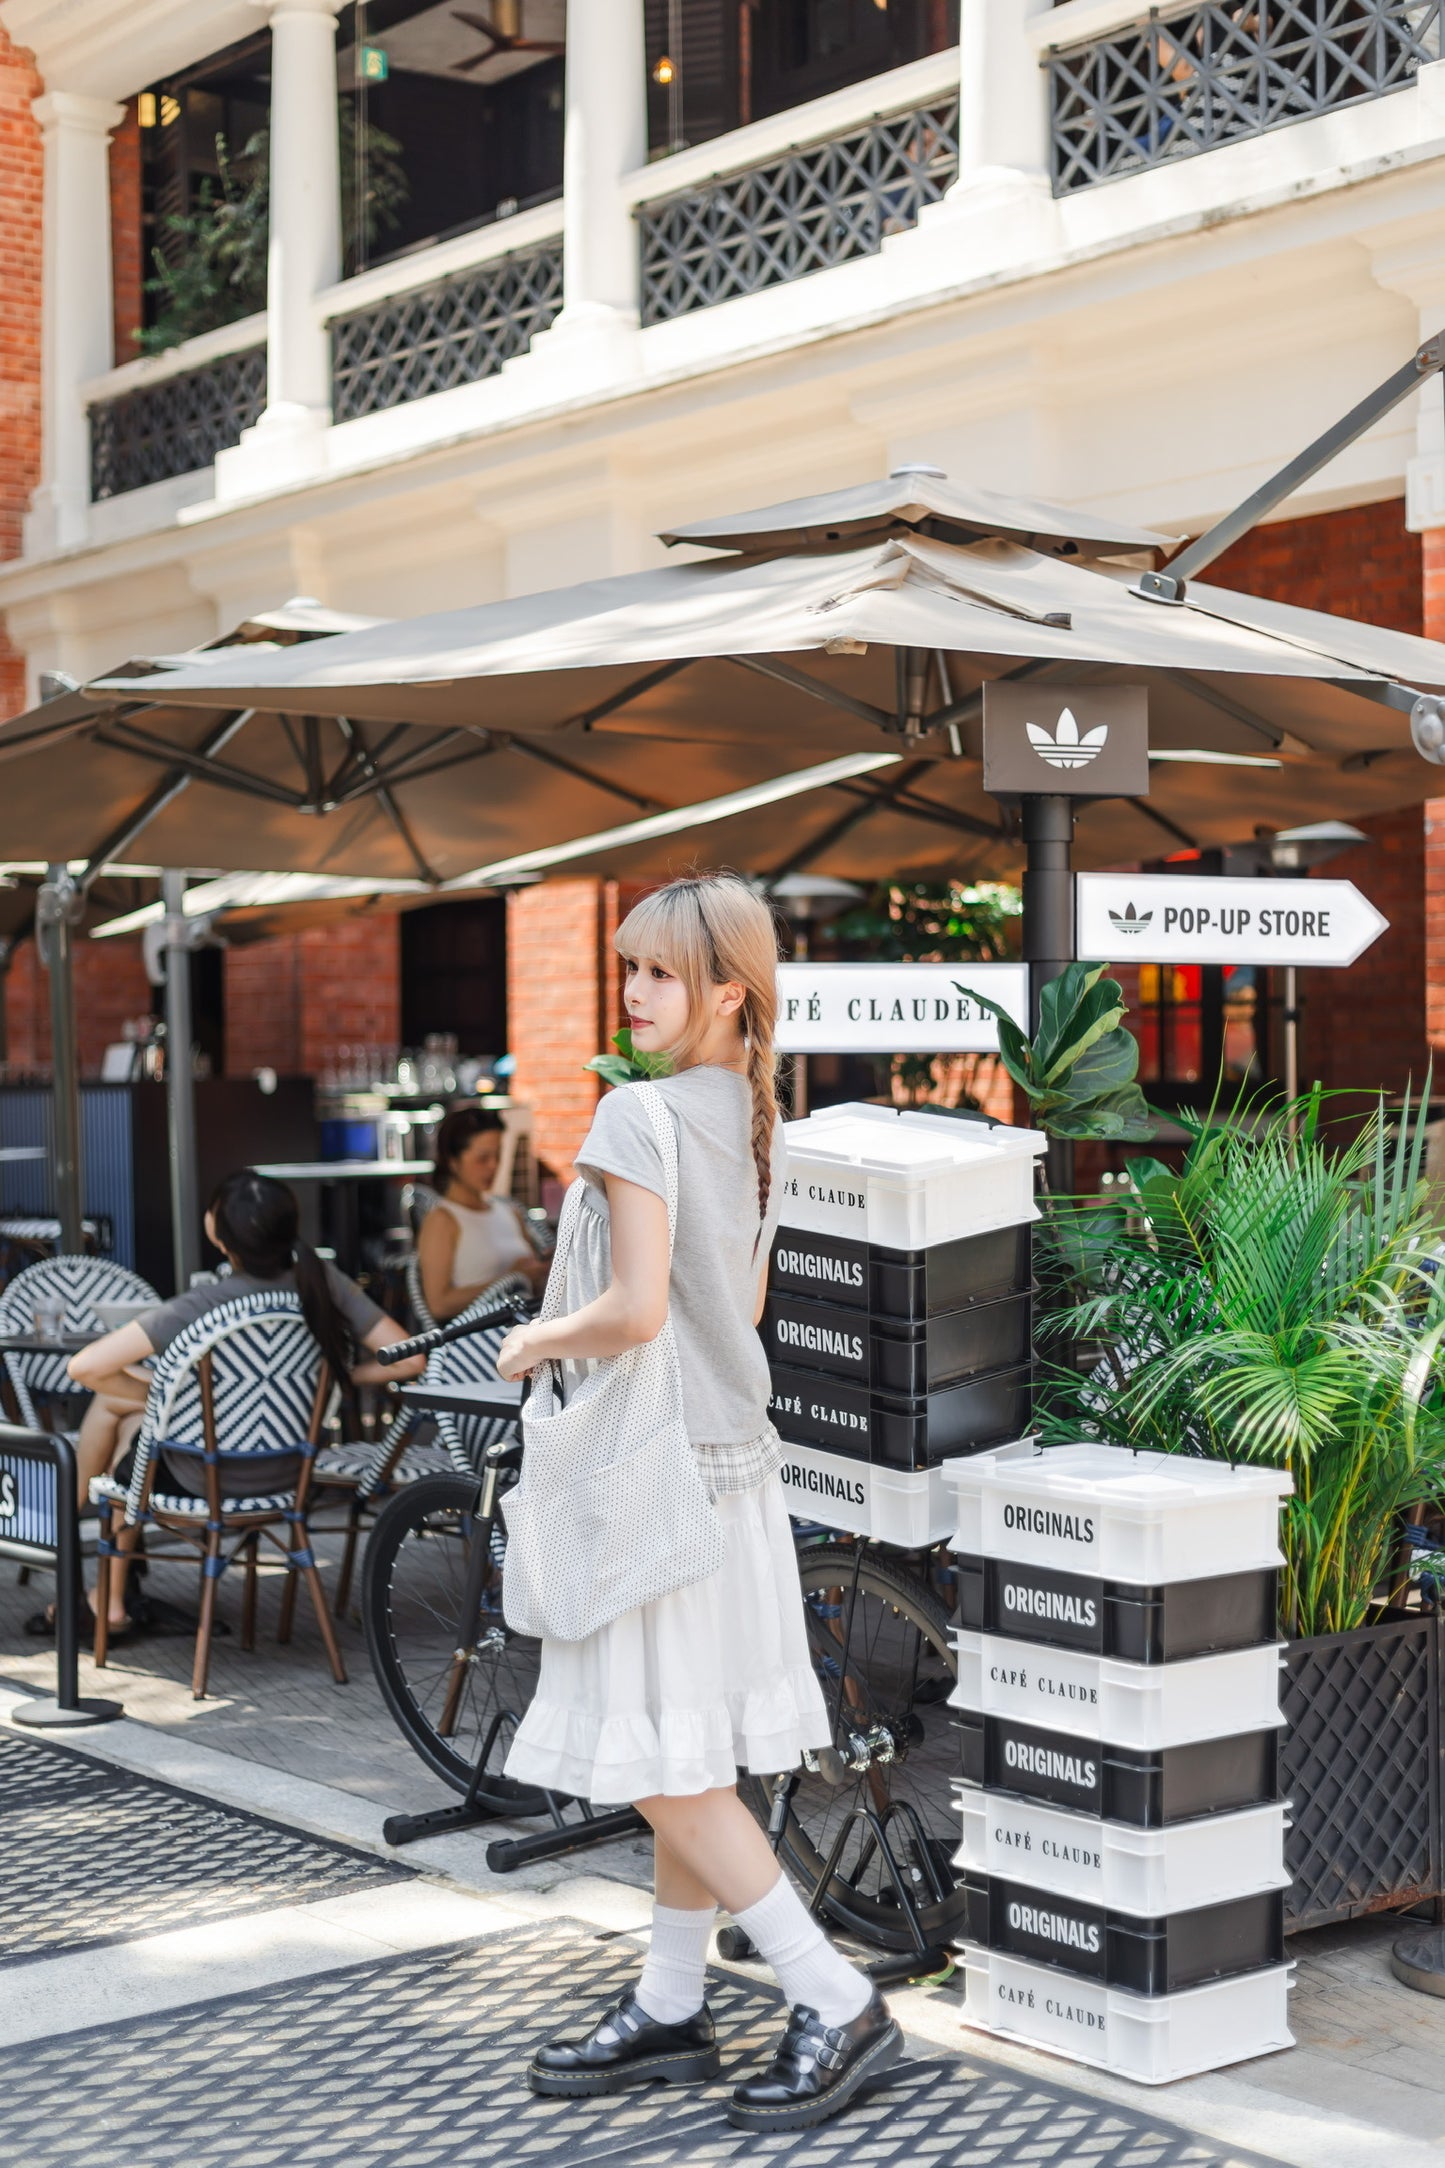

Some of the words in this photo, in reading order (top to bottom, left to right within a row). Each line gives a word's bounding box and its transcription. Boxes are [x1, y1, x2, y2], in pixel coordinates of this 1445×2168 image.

[1163, 907, 1251, 935] POP-UP
[1258, 909, 1331, 937] STORE
[786, 992, 822, 1022] FÉ
[808, 1185, 866, 1209] CLAUDE
[777, 1248, 864, 1287] ORIGINALS
[777, 1318, 864, 1361] ORIGINALS
[810, 1404, 869, 1432] CLAUDE
[780, 1463, 866, 1505] ORIGINALS
[1003, 1504, 1095, 1543] ORIGINALS
[1003, 1584, 1097, 1627] ORIGINALS
[990, 1666, 1027, 1688] CAFÉ
[1038, 1677, 1098, 1704] CLAUDE
[1005, 1740, 1097, 1789] ORIGINALS
[995, 1828, 1032, 1851] CAFÉ
[1042, 1839, 1101, 1869] CLAUDE
[1008, 1902, 1101, 1953] ORIGINALS
[998, 1984, 1035, 2009] CAFÉ
[1046, 1999, 1106, 2031] CLAUDE
